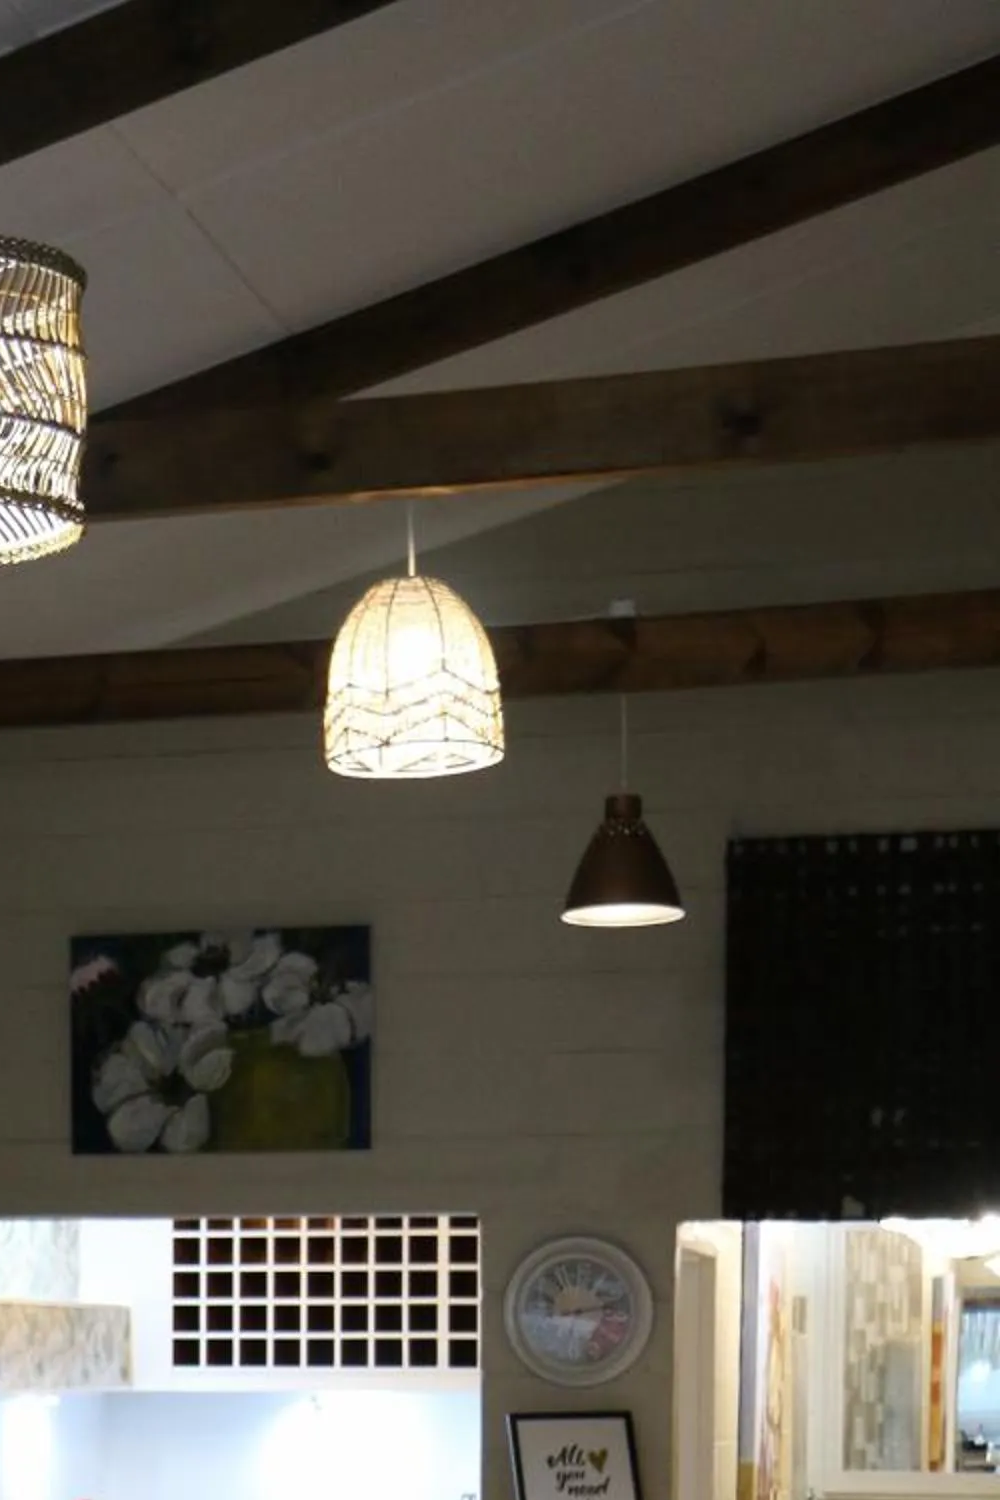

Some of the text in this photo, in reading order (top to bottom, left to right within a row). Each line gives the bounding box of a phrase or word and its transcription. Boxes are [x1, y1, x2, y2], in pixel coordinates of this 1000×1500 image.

[546, 1443, 586, 1468] All
[555, 1470, 585, 1492] you
[567, 1476, 610, 1497] need
